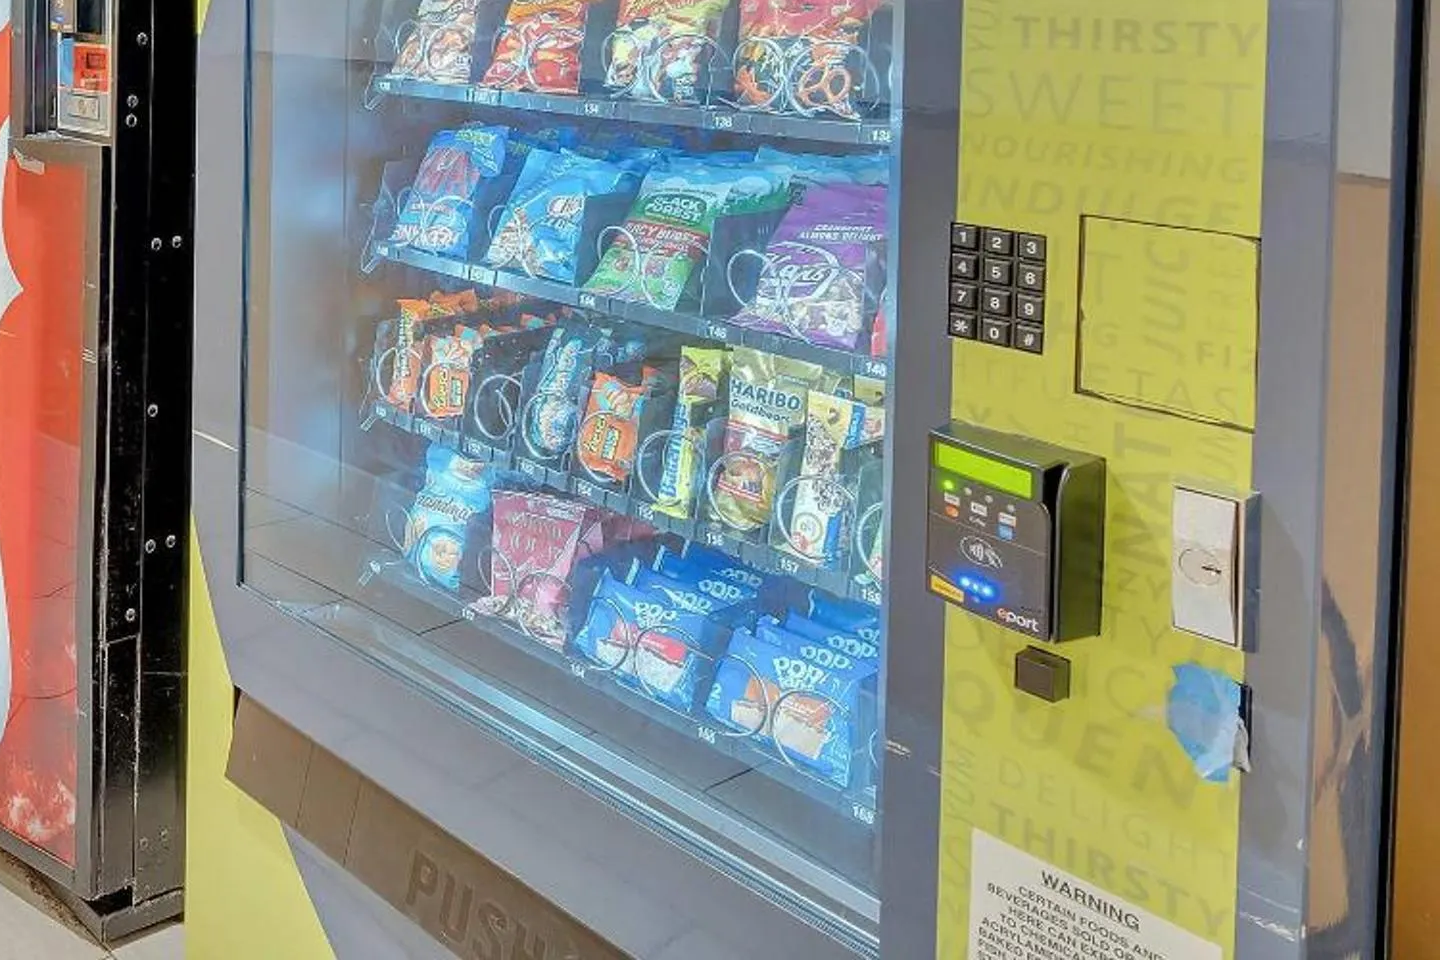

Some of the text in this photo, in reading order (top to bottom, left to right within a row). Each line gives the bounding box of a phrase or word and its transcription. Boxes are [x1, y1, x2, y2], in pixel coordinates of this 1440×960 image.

[1012, 15, 1262, 58] THIRSTY
[965, 64, 1255, 139] SWEET
[960, 231, 1037, 254] 1 2 3
[957, 261, 1036, 285] 4 5 6
[957, 290, 1034, 315] 7 8 9
[989, 327, 999, 339] 0
[731, 378, 801, 411] HARIBO
[780, 557, 800, 574] 157
[987, 882, 1069, 932] BEVERAGES
[1072, 925, 1111, 952] SOLD
[1018, 886, 1077, 922] CERTAIN
[1080, 916, 1130, 949] FOODS
[1041, 870, 1141, 933] WARNING
[1009, 906, 1045, 931] HERE
[1047, 926, 1079, 949] CAN
